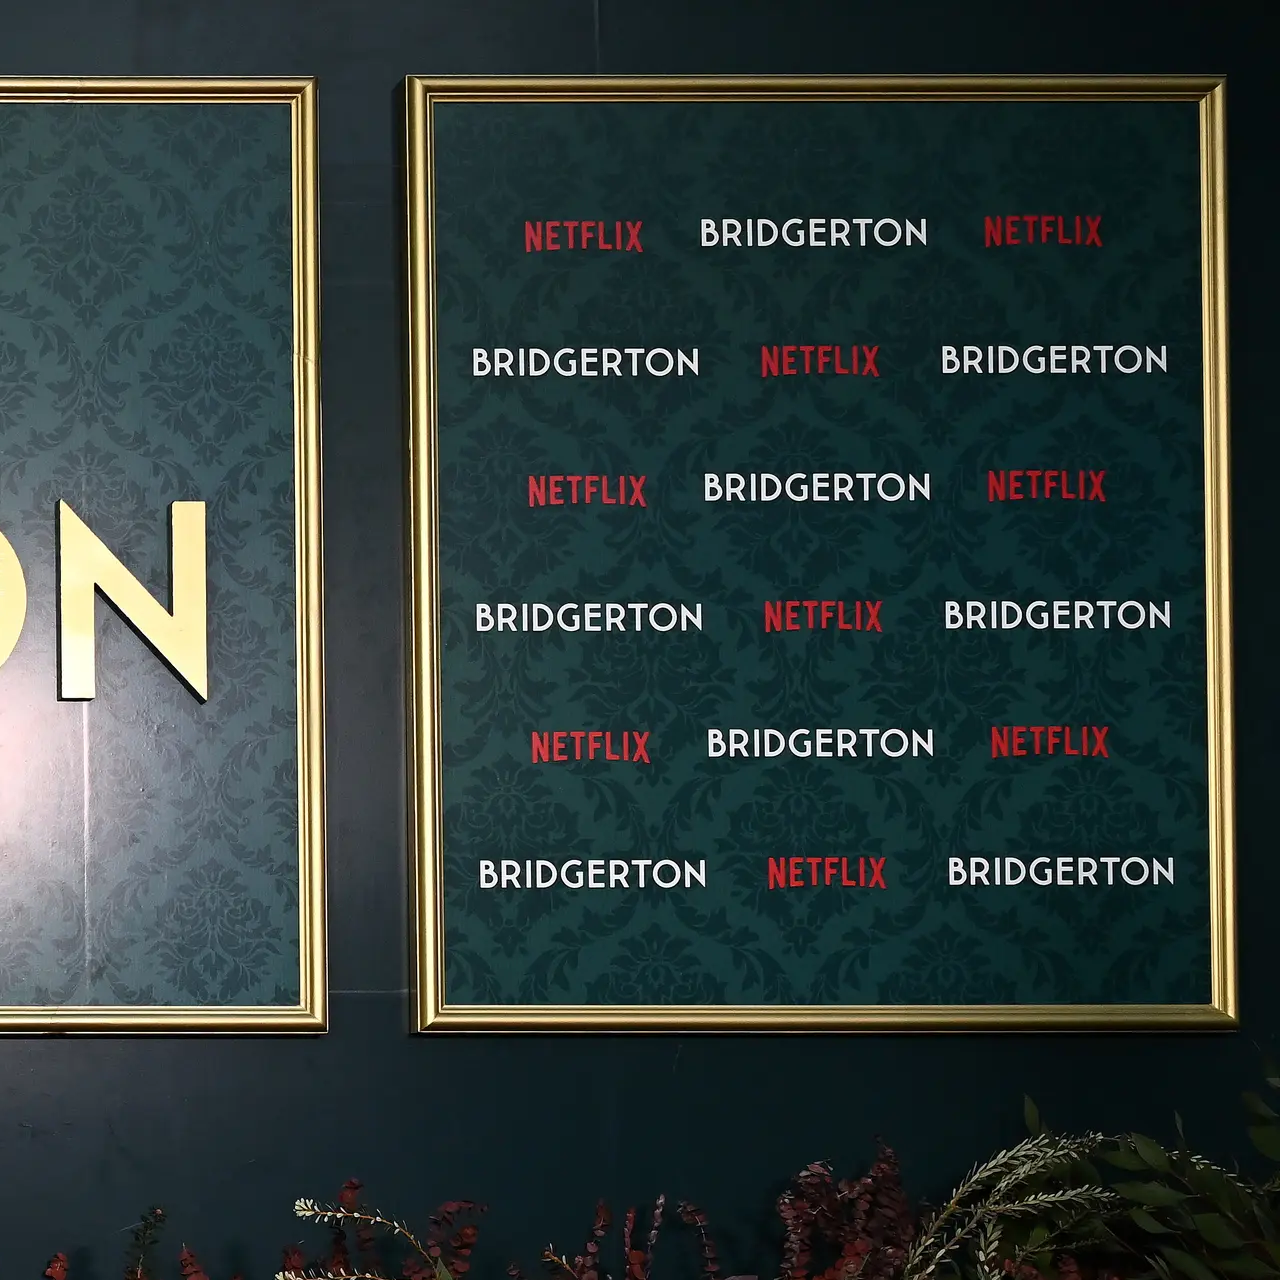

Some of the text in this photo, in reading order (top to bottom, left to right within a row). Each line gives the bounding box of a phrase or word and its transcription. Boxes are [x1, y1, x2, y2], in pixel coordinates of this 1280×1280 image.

[525, 215, 1103, 253] NETFLIX BRIDGERTON NETFLIX
[472, 345, 1167, 378] BRIDGERTON NETFLIX BRIDGERTON
[528, 469, 1106, 507] NETFLIX BRIDGERTON NETFLIX
[476, 600, 1171, 633] BRIDGERTON NETFLIX BRIDGERTON
[531, 725, 1109, 764] NETFLIX BRIDGERTON NETFLIX
[479, 856, 1174, 890] BRIDGERTON NETFLIX BRIDGERTON
